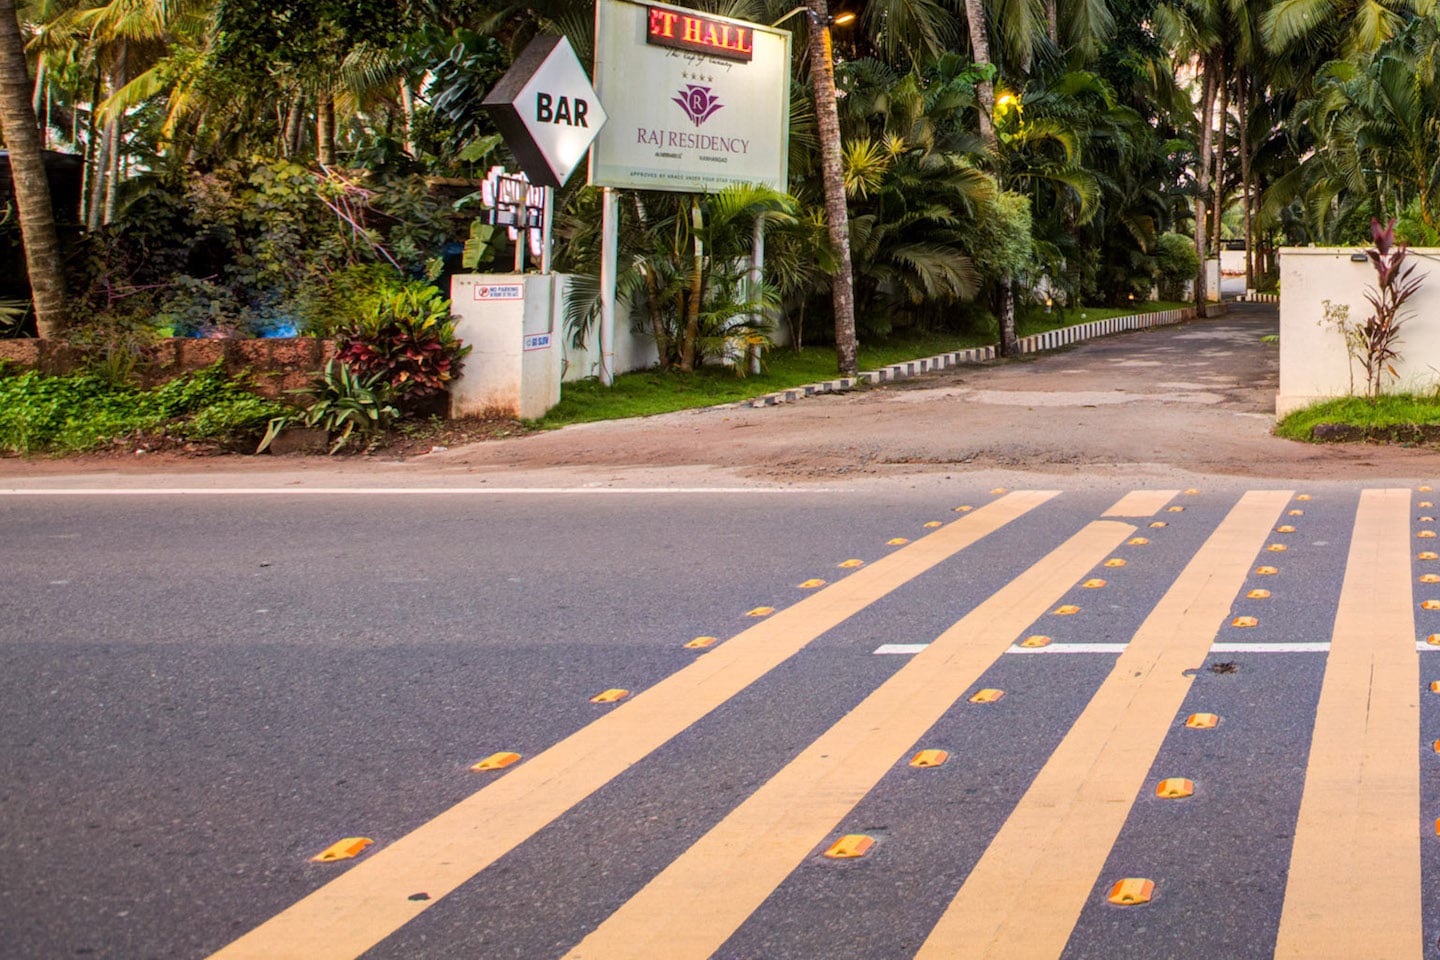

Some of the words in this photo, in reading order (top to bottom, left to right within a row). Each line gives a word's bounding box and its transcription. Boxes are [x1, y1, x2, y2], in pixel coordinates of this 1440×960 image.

[682, 16, 752, 53] HALL
[536, 91, 589, 129] BAR
[637, 127, 664, 149] RAJ
[668, 130, 750, 154] RESIDENCY
